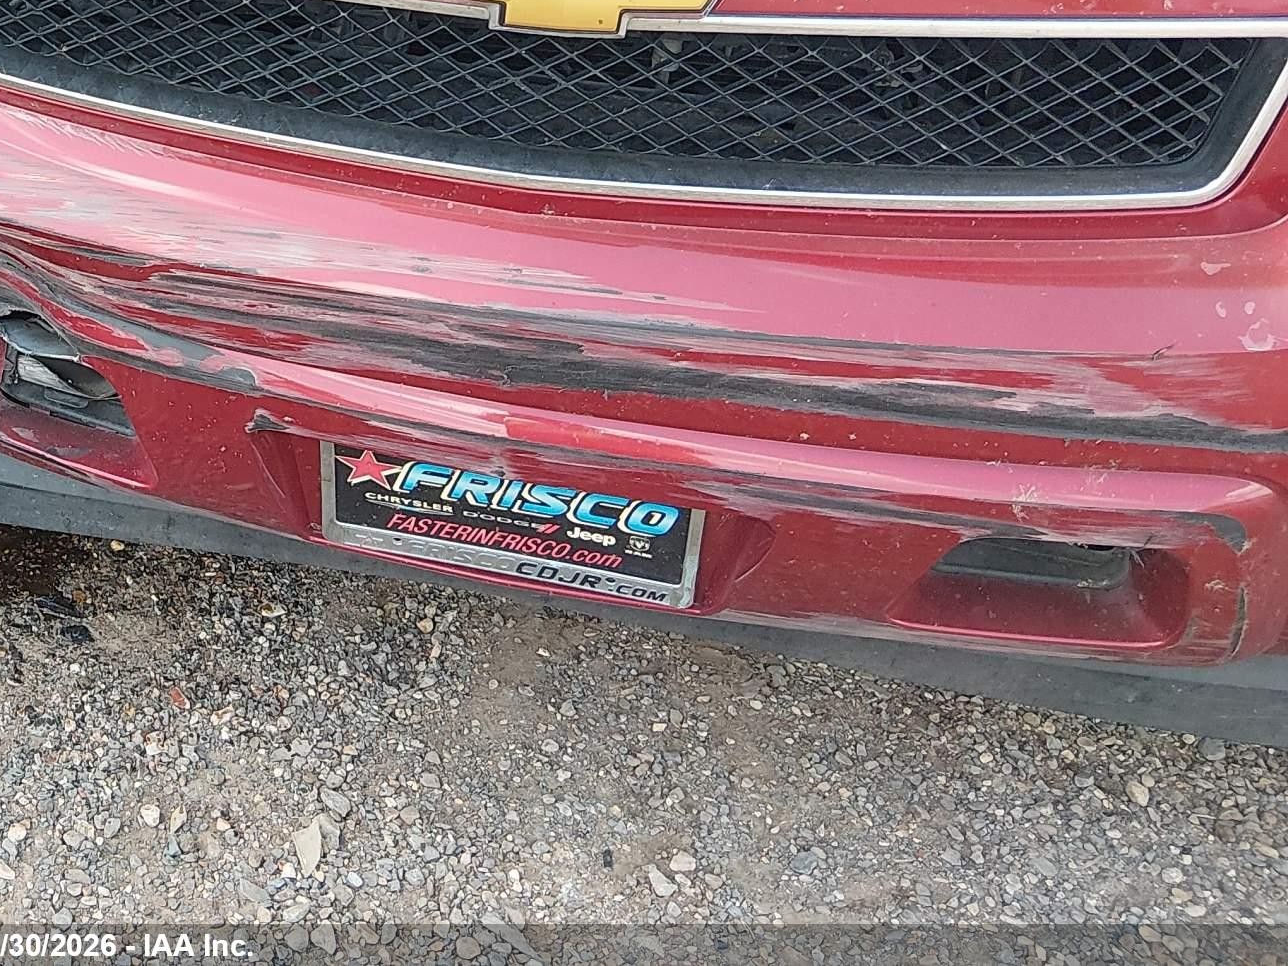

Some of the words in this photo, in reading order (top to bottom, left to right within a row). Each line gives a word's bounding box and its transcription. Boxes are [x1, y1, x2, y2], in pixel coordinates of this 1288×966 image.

[364, 491, 454, 514] CHRYSLER
[566, 527, 617, 547] Jeep
[393, 460, 681, 538] FRISCO
[387, 513, 623, 569] FASTERINFRISCO.com
